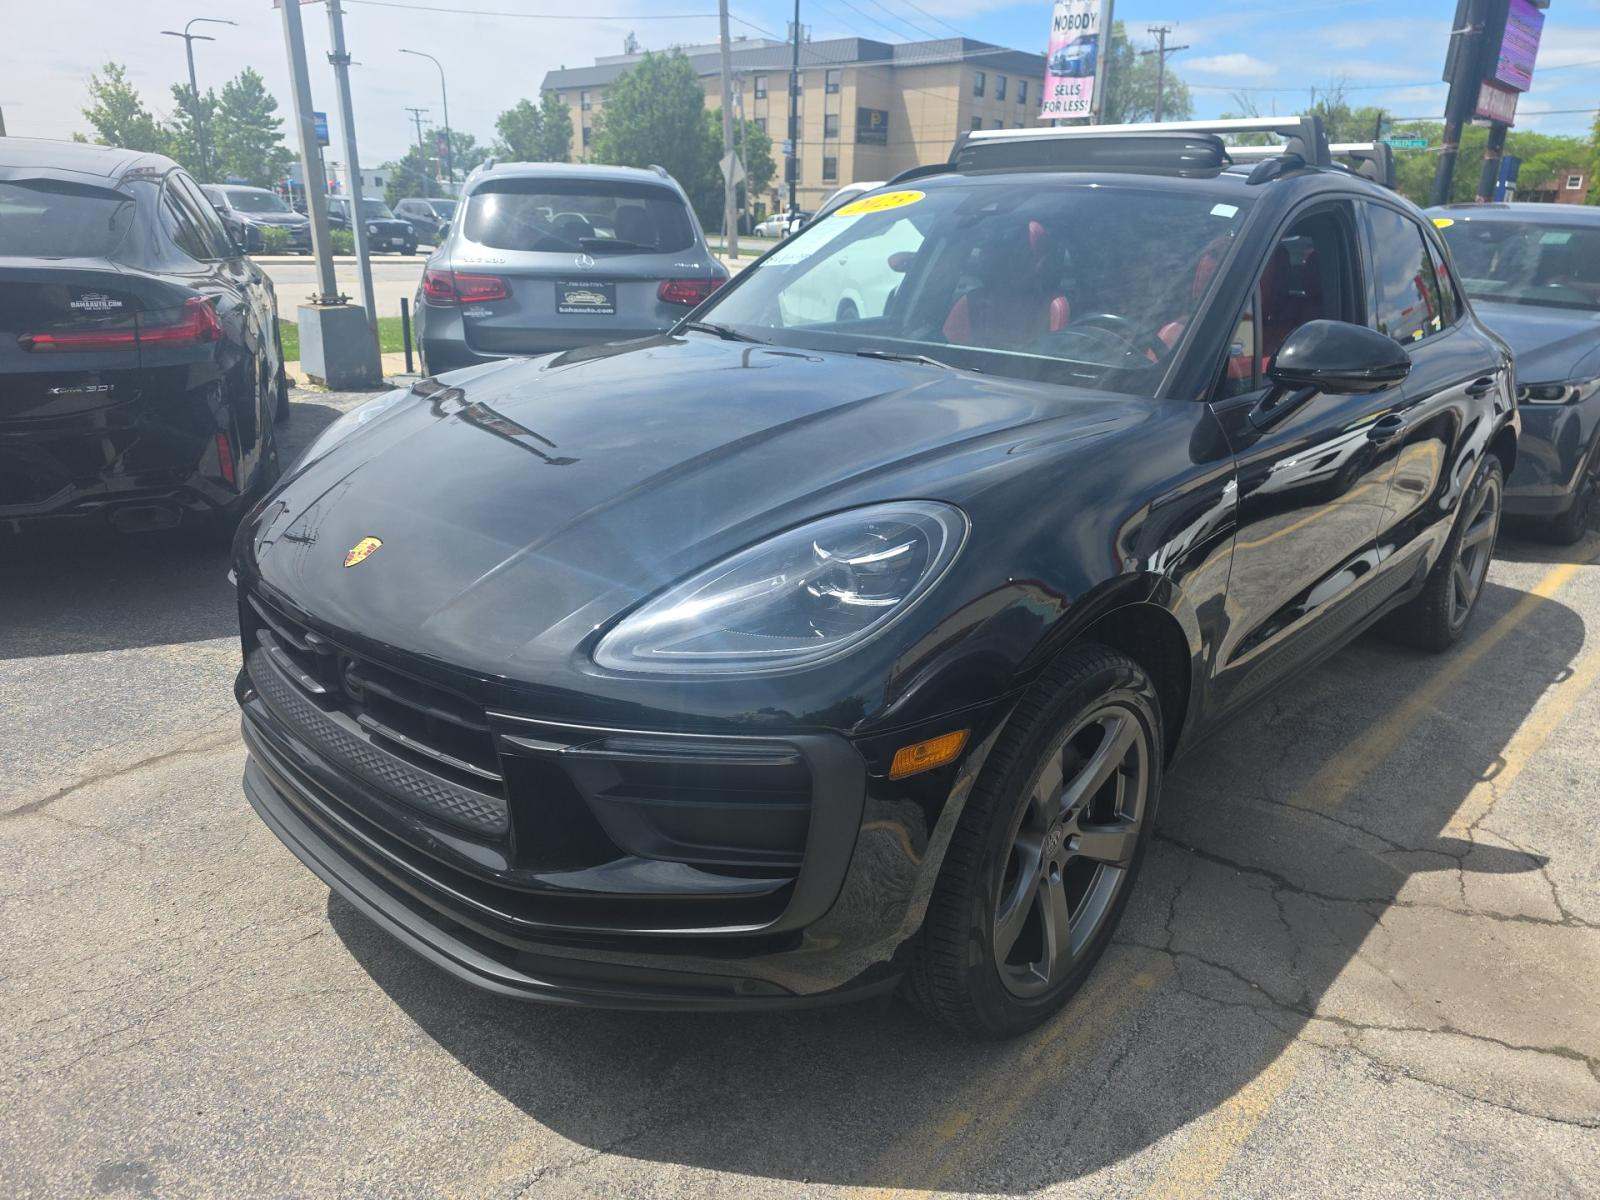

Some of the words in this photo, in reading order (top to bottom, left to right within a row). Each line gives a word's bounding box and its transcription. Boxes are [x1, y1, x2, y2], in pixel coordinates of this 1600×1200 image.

[1054, 13, 1097, 31] NOBODY
[1055, 84, 1081, 96] SELLS
[1043, 101, 1061, 113] FOR
